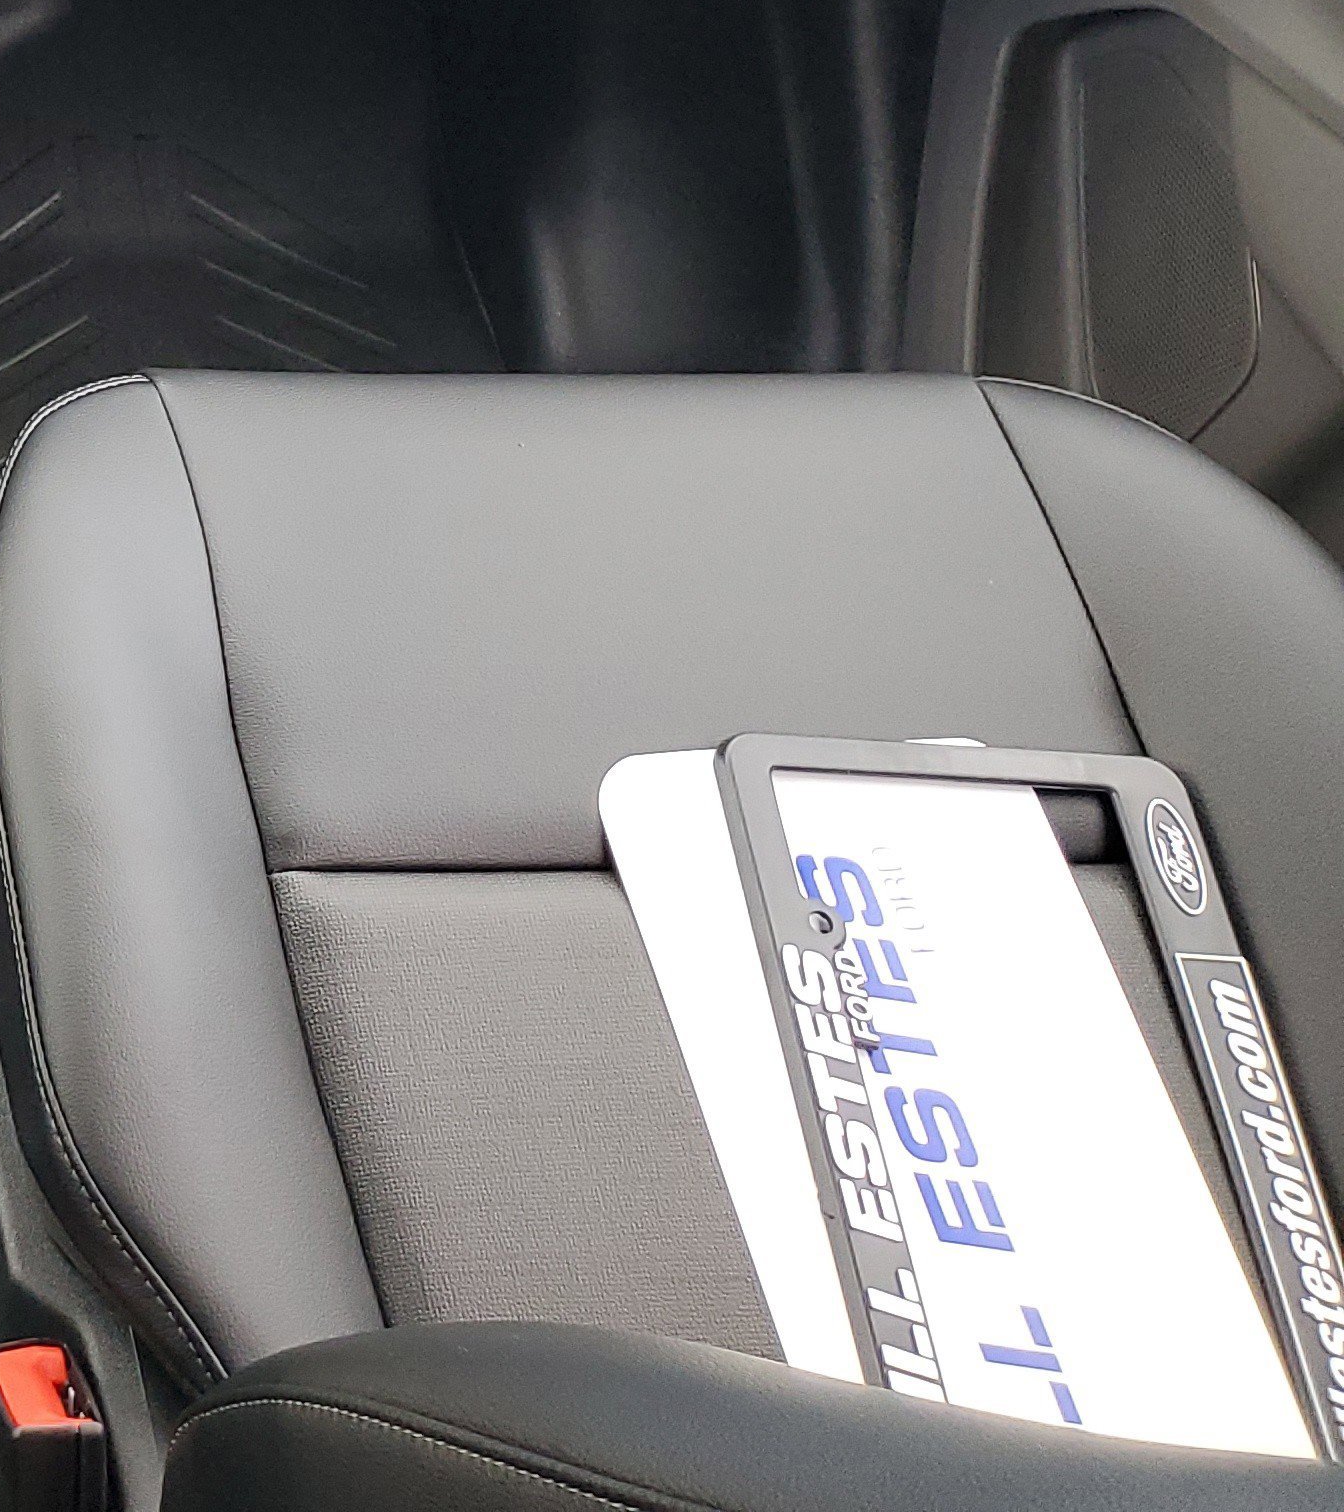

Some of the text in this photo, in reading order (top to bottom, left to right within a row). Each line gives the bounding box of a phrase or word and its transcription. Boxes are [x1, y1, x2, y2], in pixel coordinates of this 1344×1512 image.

[782, 944, 904, 1241] ESTES
[796, 854, 1015, 1252] ESTES
[835, 951, 882, 1042] FORD
